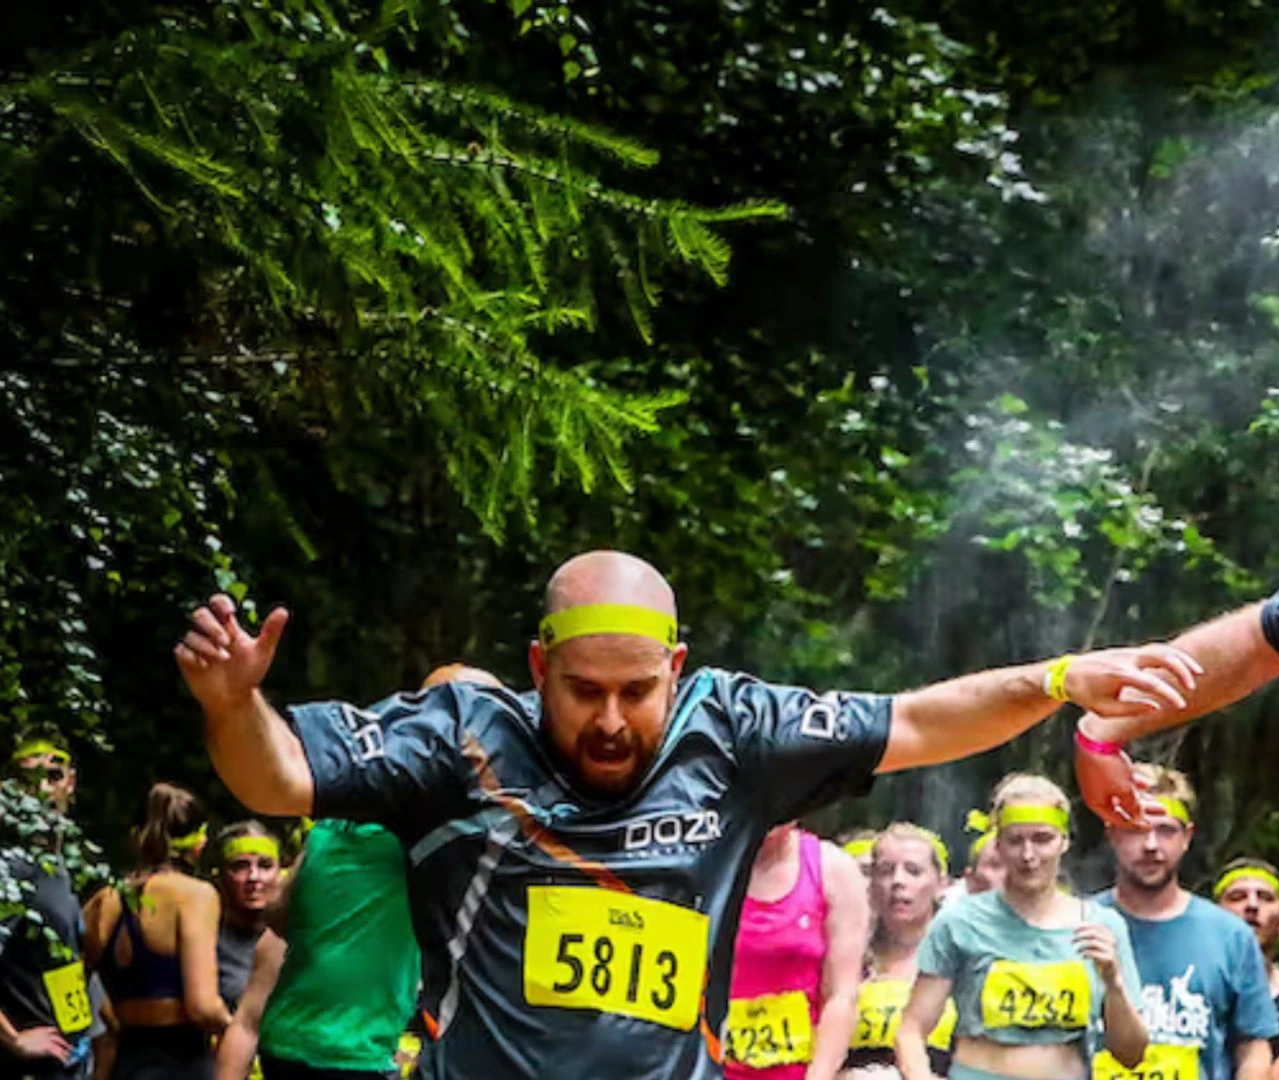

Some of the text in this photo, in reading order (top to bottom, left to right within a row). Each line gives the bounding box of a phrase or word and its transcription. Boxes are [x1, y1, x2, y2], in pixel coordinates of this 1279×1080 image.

[625, 810, 721, 850] DOZA
[552, 933, 678, 1012] 5813
[999, 986, 1076, 1023] 4232
